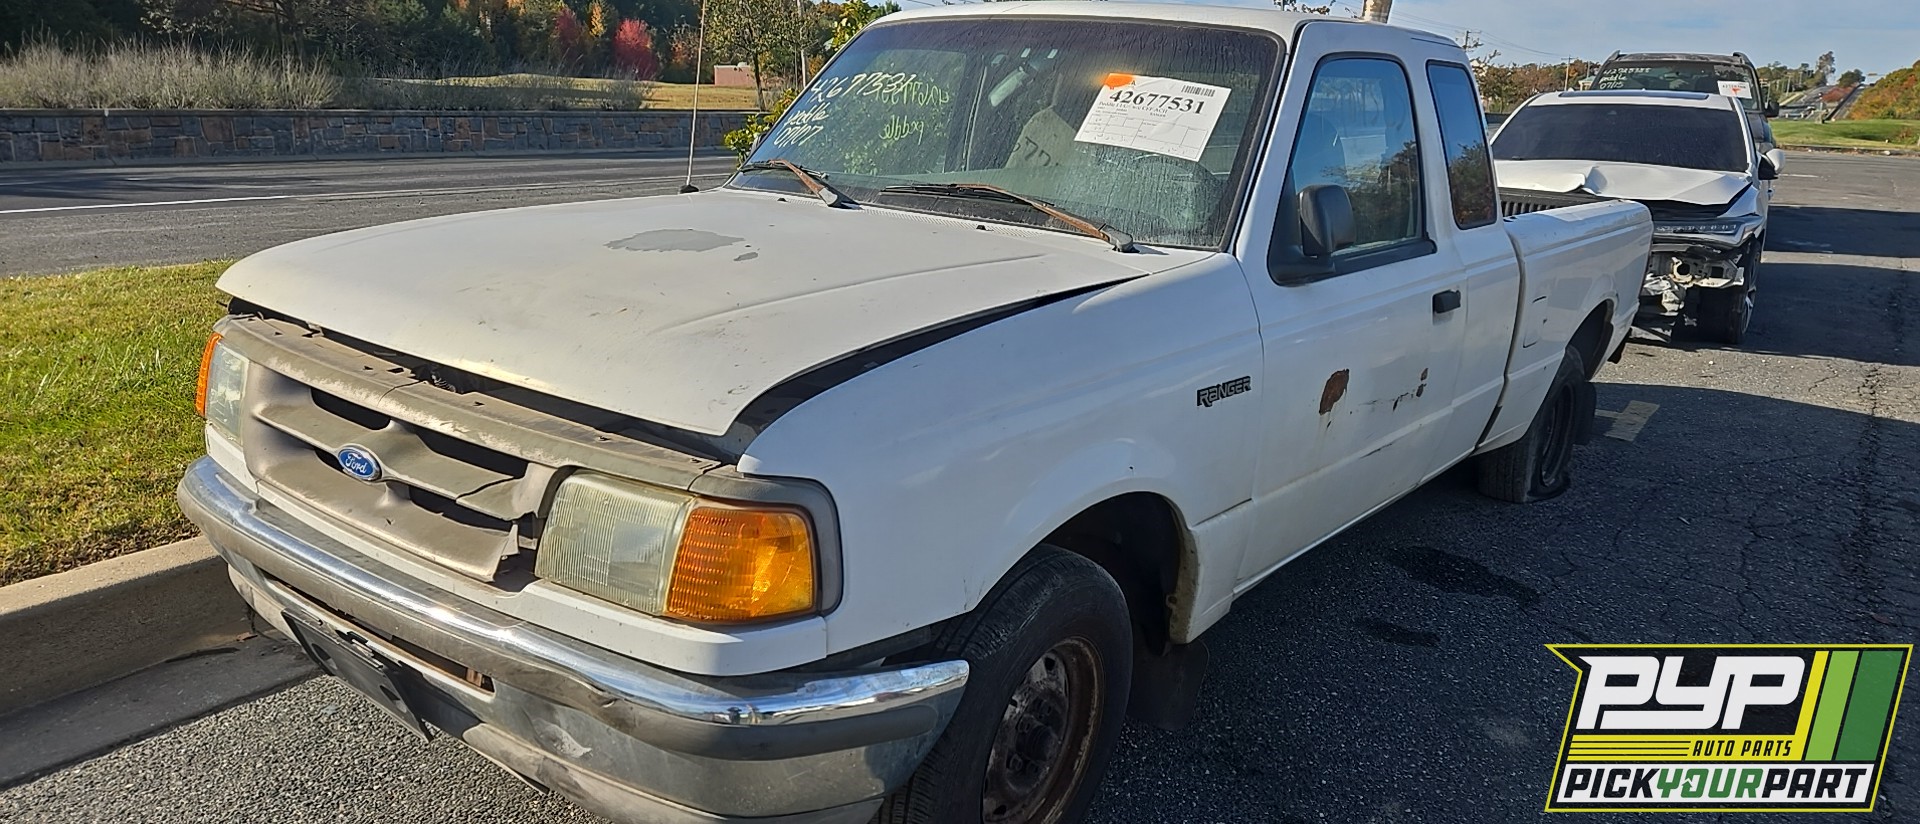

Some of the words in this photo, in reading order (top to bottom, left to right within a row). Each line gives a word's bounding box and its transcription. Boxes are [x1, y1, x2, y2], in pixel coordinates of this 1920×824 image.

[1109, 89, 1205, 115] 42677531
[1197, 375, 1252, 407] RANGER
[345, 453, 367, 474] Ford
